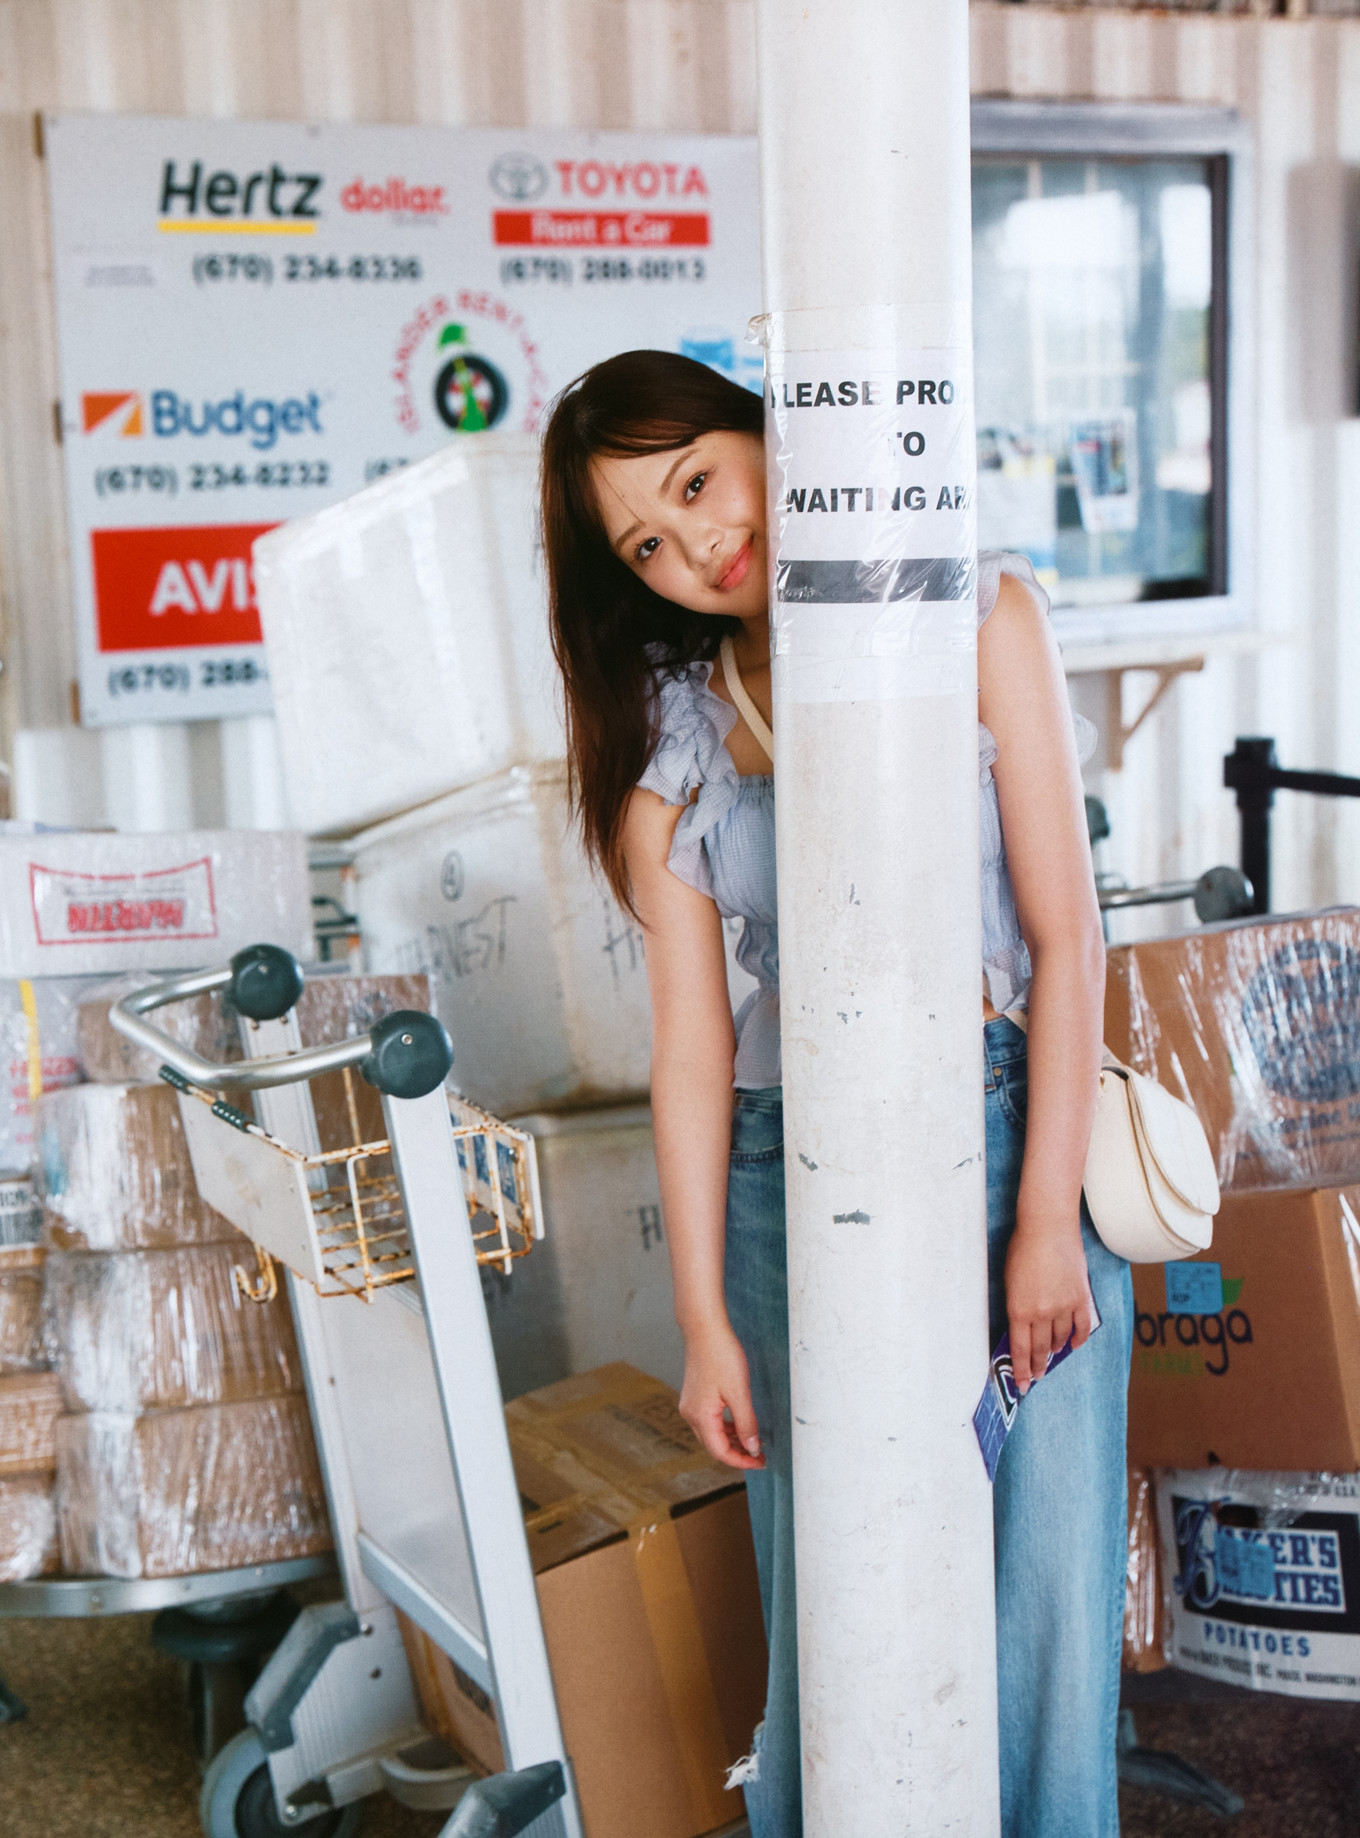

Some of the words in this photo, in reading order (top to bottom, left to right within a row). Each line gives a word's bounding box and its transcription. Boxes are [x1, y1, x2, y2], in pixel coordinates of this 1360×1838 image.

[159, 158, 323, 217] Hertz
[555, 160, 709, 198] TOYOTA
[531, 210, 596, 243] Rent
[625, 210, 673, 242] Car
[192, 253, 274, 288] (670)
[501, 256, 573, 288] (670)
[896, 379, 955, 406] PRO
[151, 388, 323, 450] Budget
[95, 463, 179, 498] (670)
[786, 485, 927, 513] WAITING
[150, 557, 257, 616] AVI
[108, 663, 191, 697] (670)
[1134, 1300, 1253, 1376] braga
[1204, 1621, 1311, 1658] POTATOES
